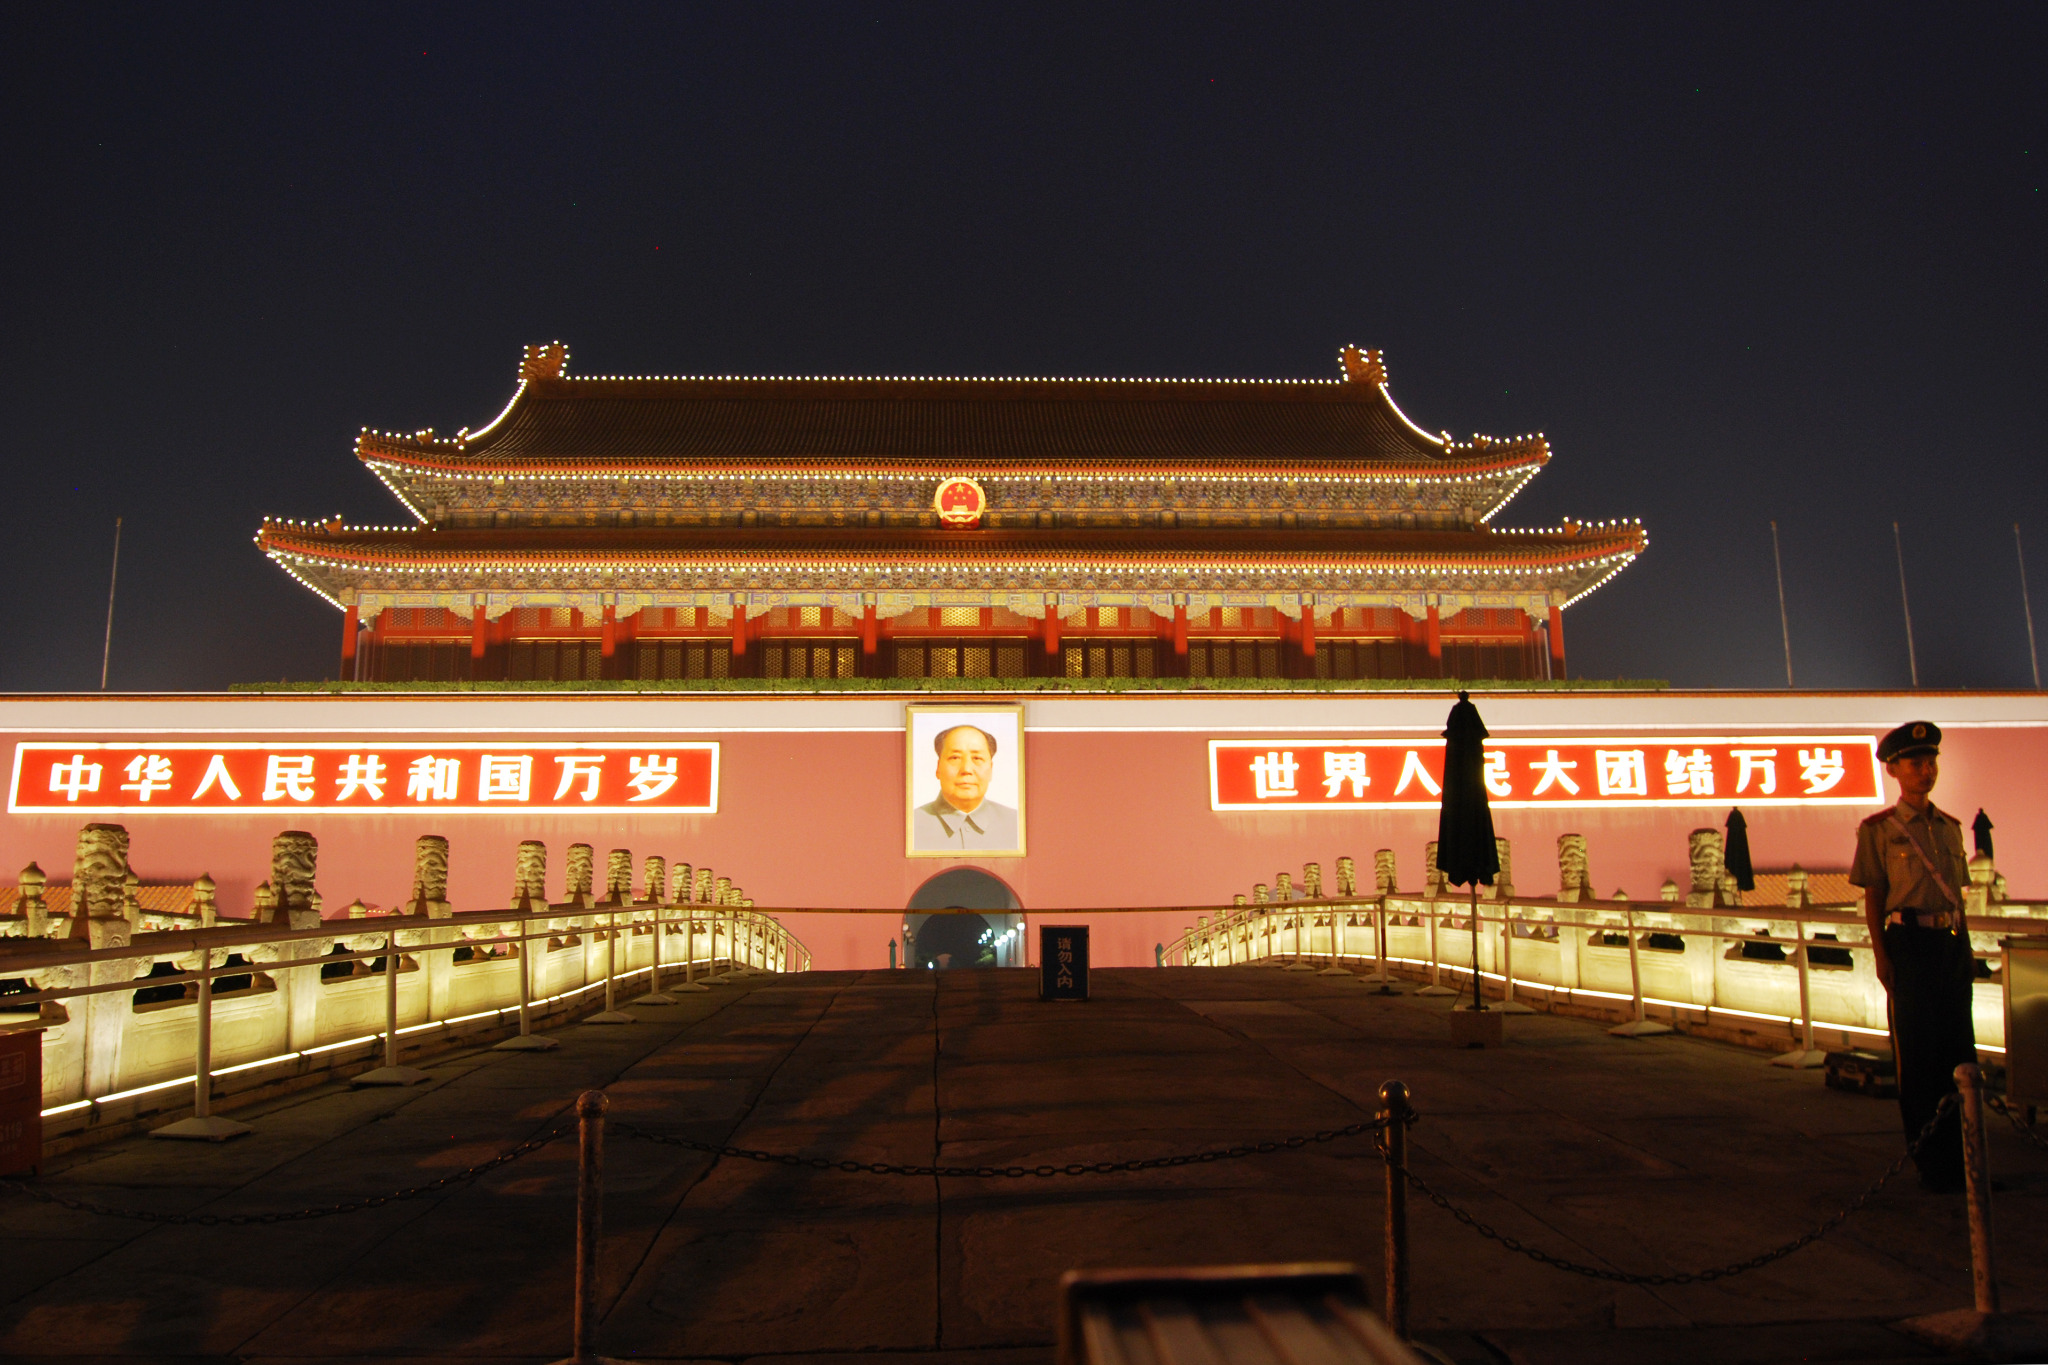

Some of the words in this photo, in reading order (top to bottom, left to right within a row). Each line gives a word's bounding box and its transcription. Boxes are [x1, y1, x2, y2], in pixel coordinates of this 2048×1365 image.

[49, 754, 680, 802] 中华人民共和国万岁
[1057, 937, 1073, 989] 请勿入内
